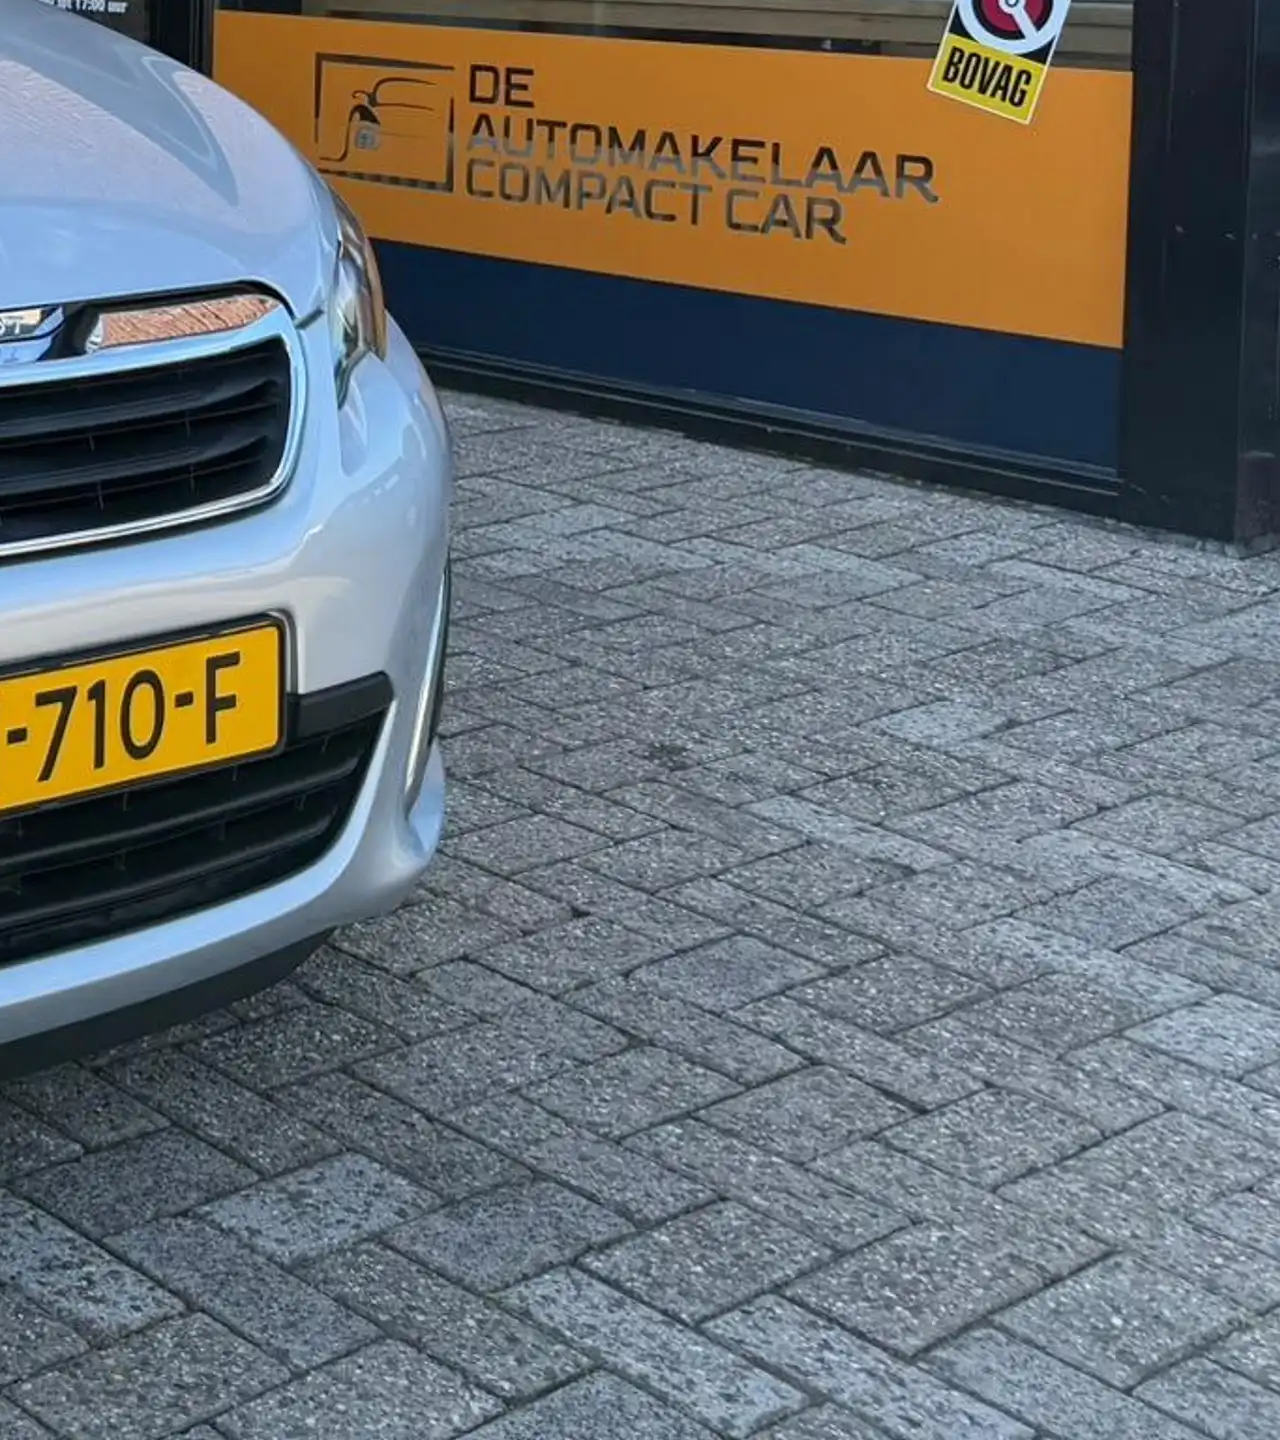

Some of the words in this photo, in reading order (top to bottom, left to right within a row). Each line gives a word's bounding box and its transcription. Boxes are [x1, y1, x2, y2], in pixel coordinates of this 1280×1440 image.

[107, 1, 128, 13] uur
[468, 63, 536, 108] DE
[941, 45, 1033, 109] BOVAG
[466, 112, 940, 204] AUTOMAKELAAR
[465, 157, 713, 227] COMPACT
[726, 186, 847, 245] CAR
